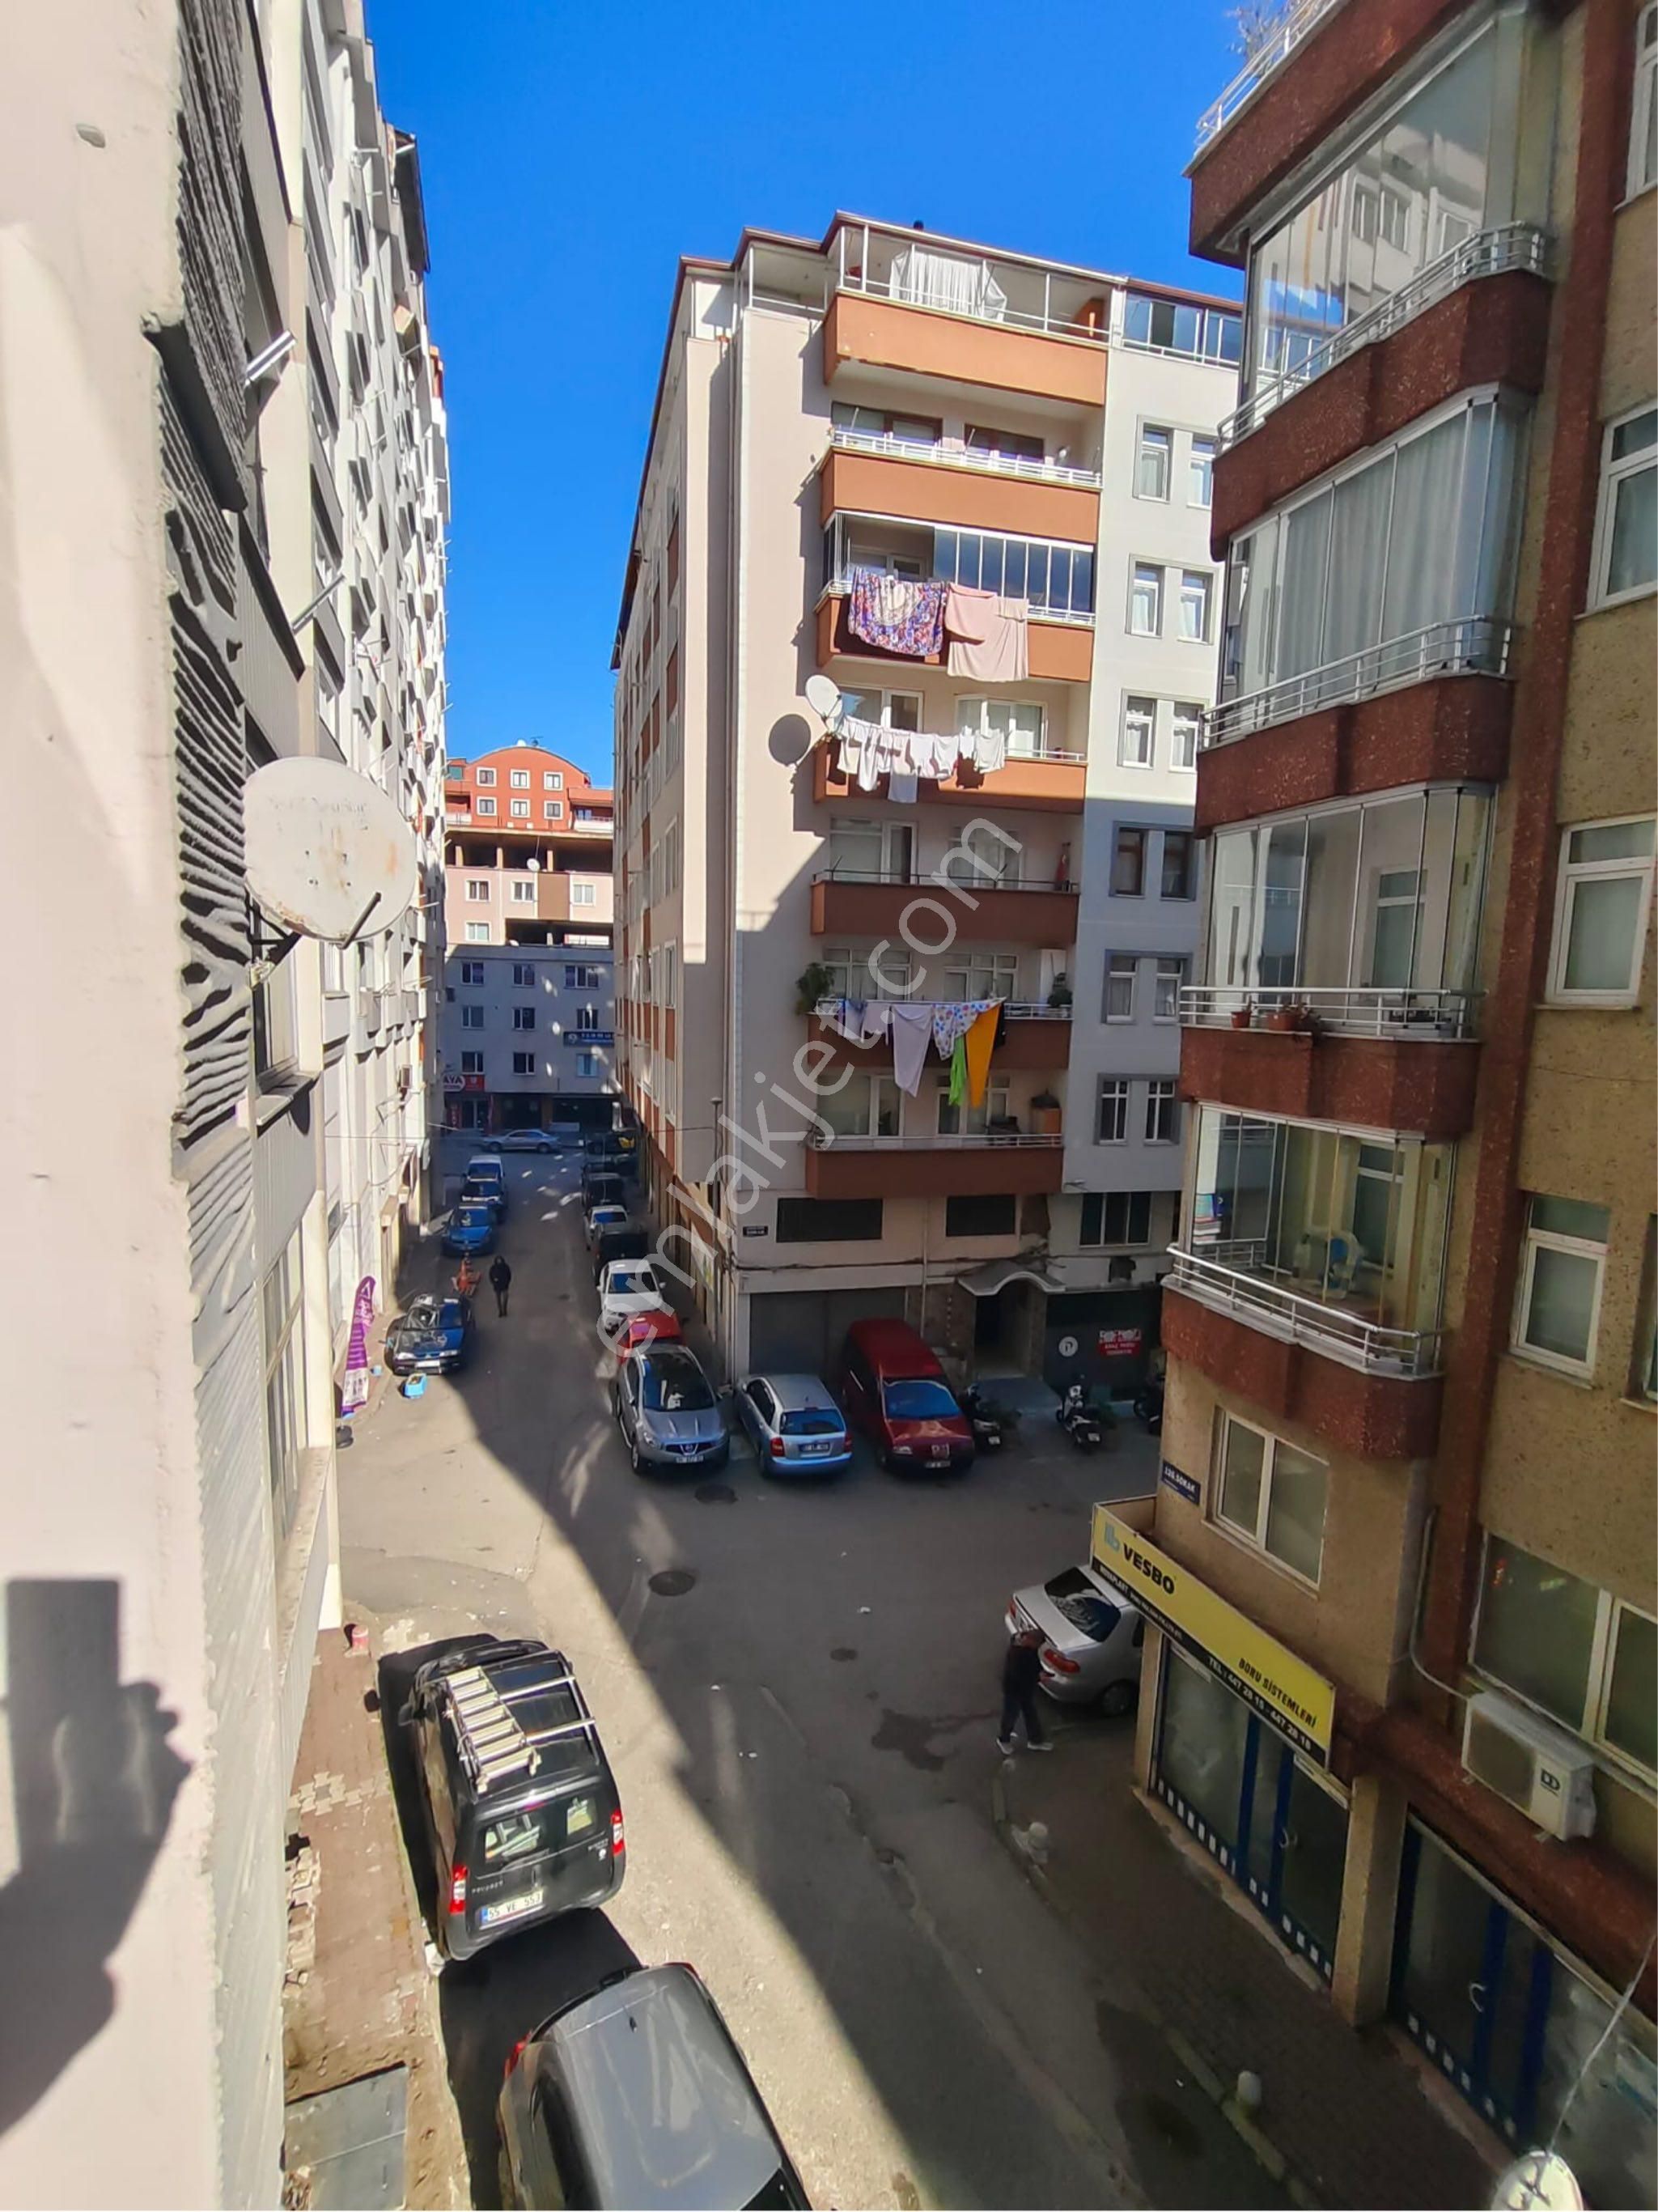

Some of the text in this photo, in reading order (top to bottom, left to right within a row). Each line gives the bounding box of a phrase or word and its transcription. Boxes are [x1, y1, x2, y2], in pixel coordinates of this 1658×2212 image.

[1123, 1543, 1175, 1594] VESBO
[1239, 1658, 1317, 1728] BORU SİSTEMLERİ
